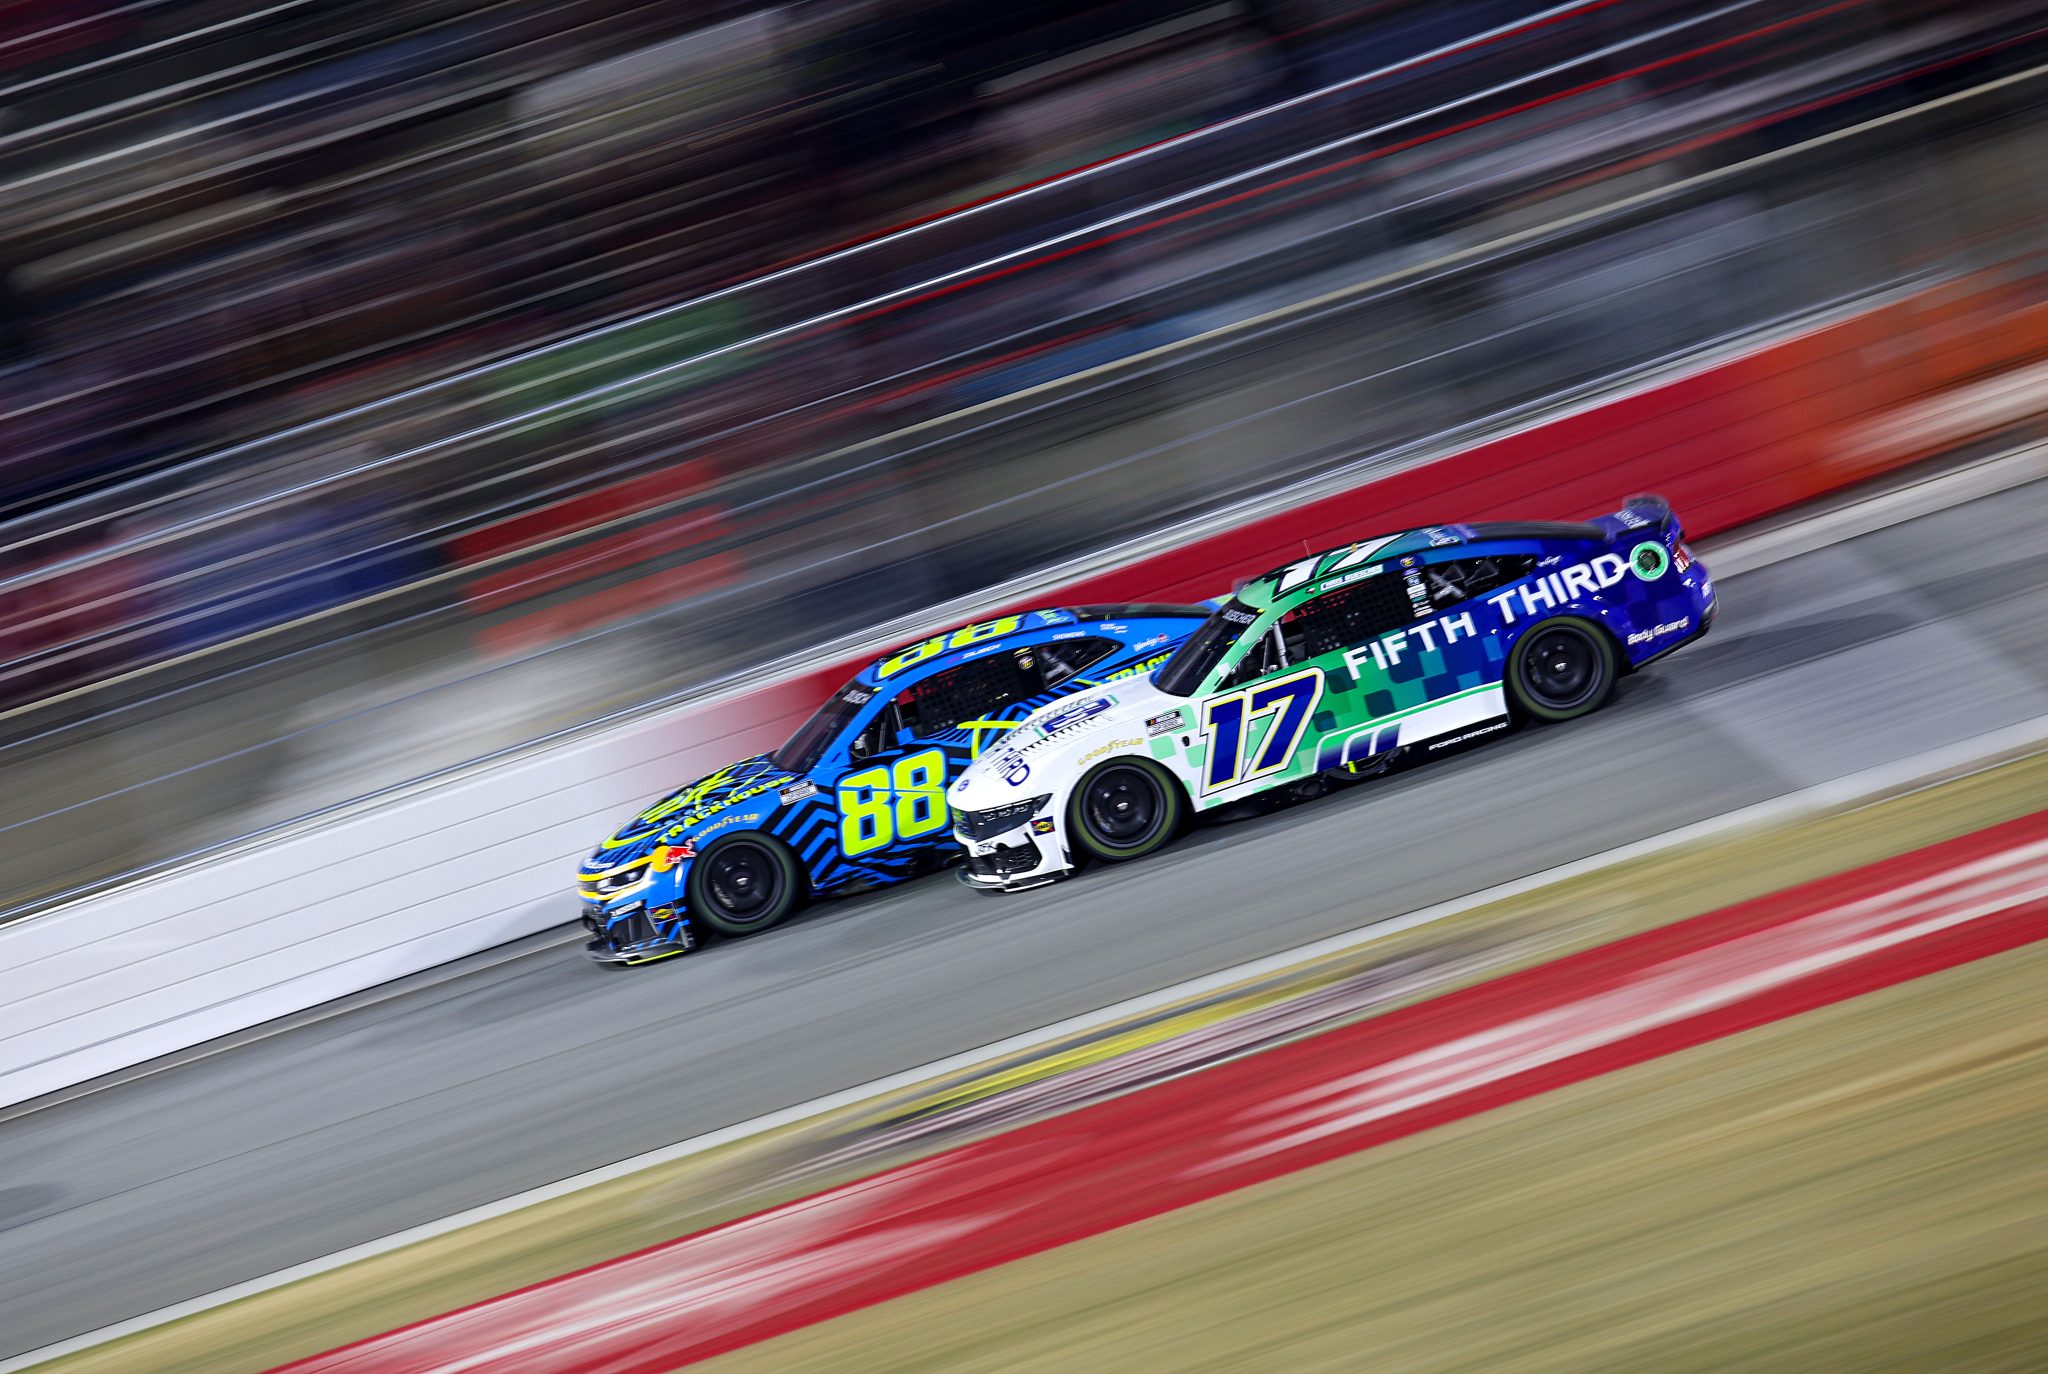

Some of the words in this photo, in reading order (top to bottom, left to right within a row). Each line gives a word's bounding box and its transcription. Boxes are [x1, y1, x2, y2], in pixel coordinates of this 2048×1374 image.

[1342, 611, 1478, 681] FIFTH
[1487, 552, 1626, 625] THIRD
[1077, 736, 1144, 766] GOODYEAR
[1204, 670, 1321, 792] 17
[1463, 721, 1509, 741] RACING
[655, 775, 796, 844] TRACKHOUSE
[838, 749, 948, 857] 88
